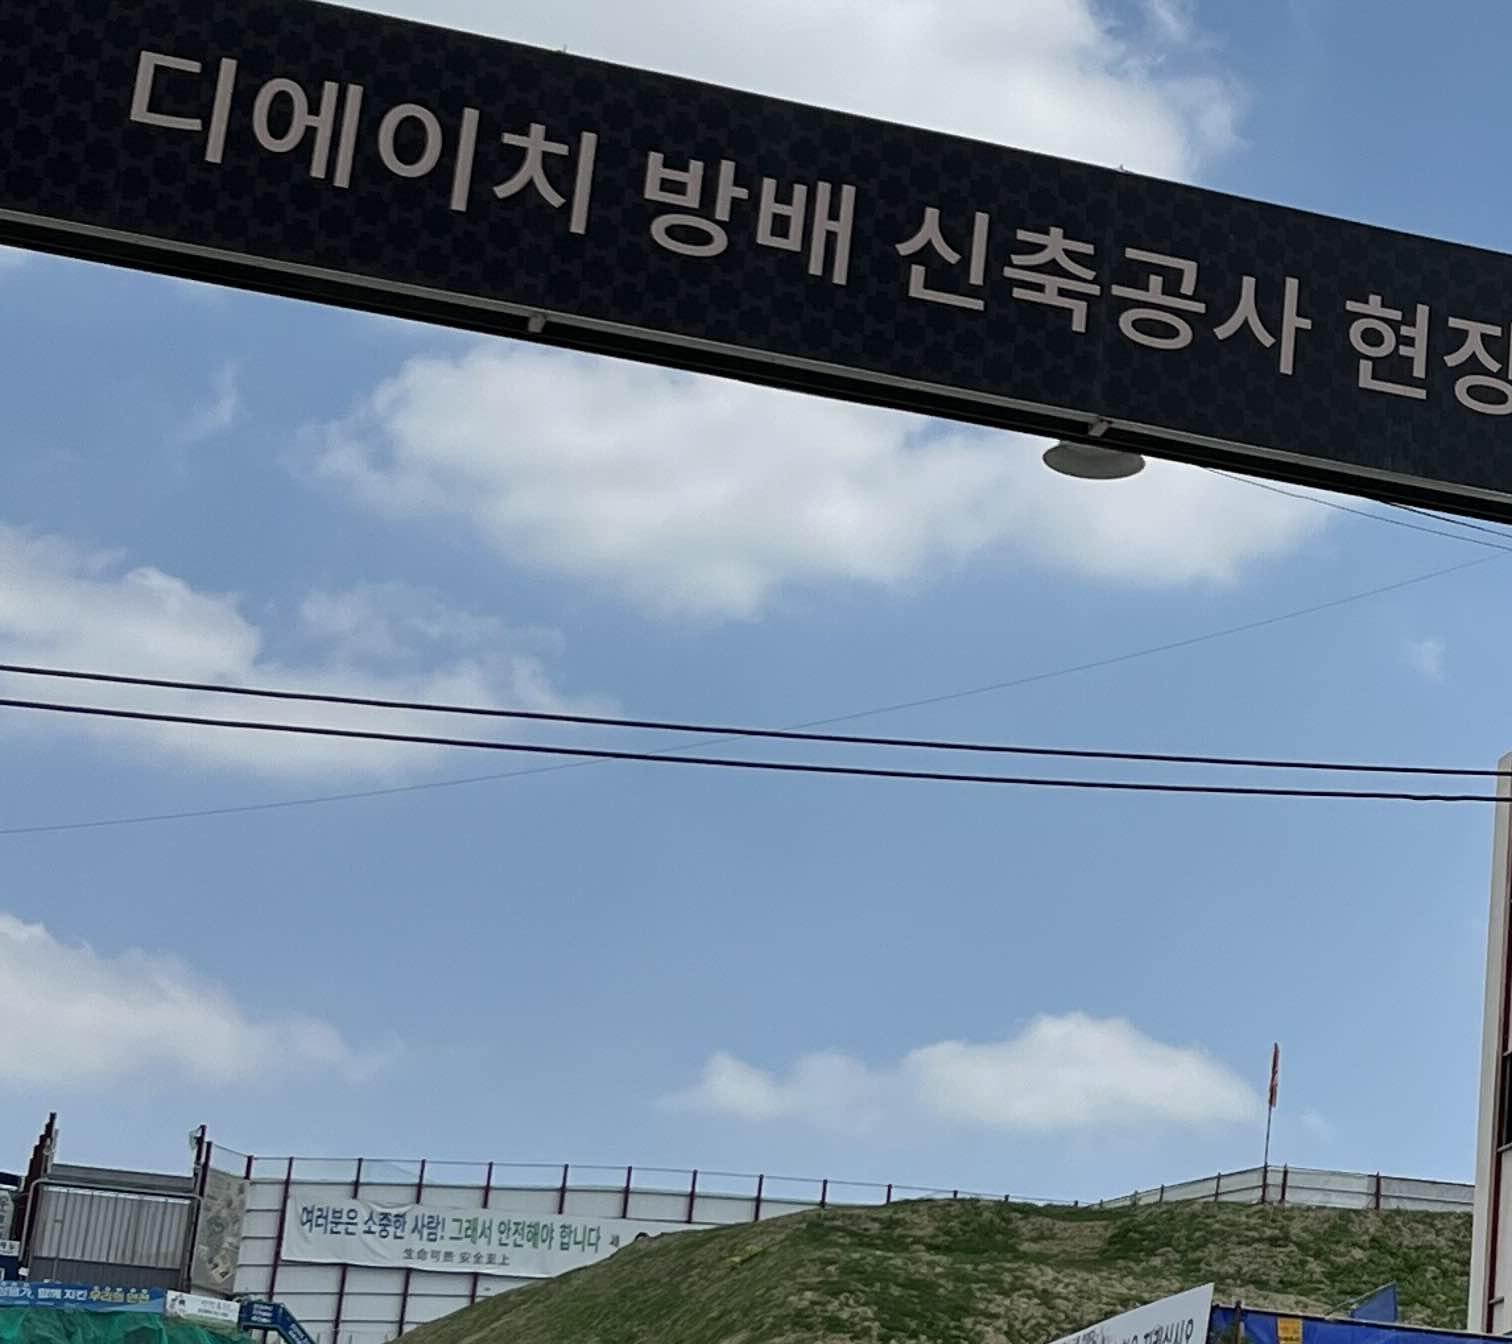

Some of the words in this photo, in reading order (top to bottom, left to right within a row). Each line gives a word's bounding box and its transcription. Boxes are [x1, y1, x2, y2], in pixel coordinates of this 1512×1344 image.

[130, 50, 598, 235] 디에이치
[645, 150, 857, 286] 방배
[896, 206, 1313, 376] 신축공사
[300, 1205, 358, 1236] 여러분은
[361, 1208, 408, 1241] 소중한
[411, 1213, 446, 1243] 사람!
[451, 1217, 493, 1246] 그래서
[497, 1220, 554, 1250] 안전해야
[558, 1225, 602, 1254] 합니다
